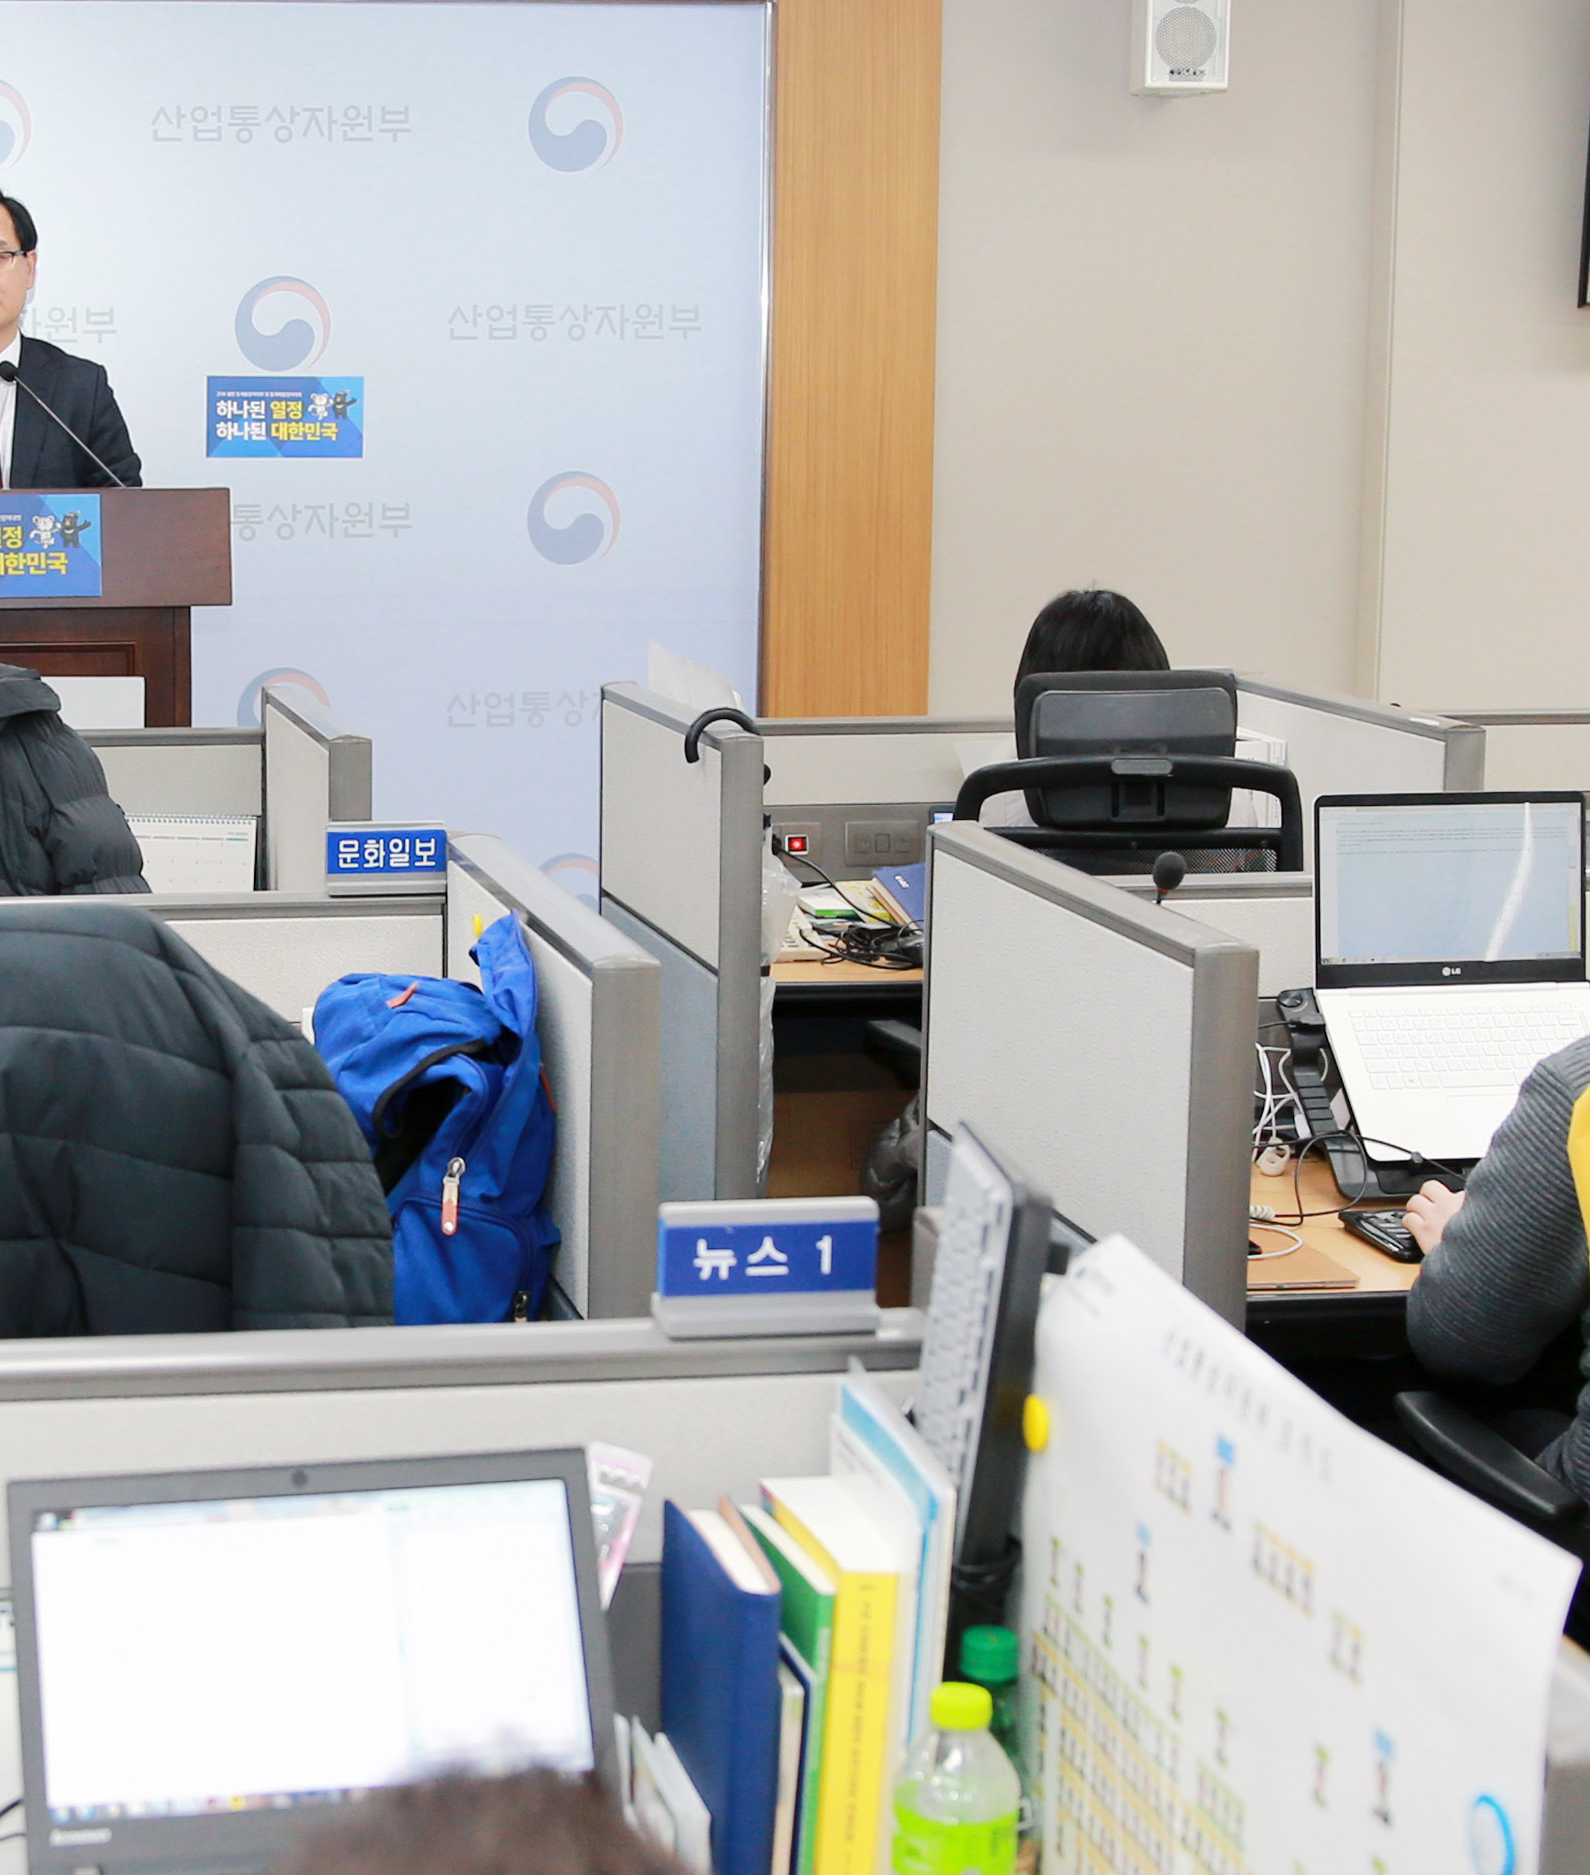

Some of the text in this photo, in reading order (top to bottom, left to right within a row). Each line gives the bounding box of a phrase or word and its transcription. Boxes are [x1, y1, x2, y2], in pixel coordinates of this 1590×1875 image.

[150, 104, 412, 144] 산업통상자원부
[447, 303, 702, 342] 산업통상자원부
[216, 400, 303, 419] 하나된 열정
[216, 421, 339, 441] 하나된 대한민국
[231, 502, 413, 542] 통상자원부
[446, 690, 600, 729] 산업통상
[338, 838, 437, 869] 문화일보
[692, 1234, 833, 1281] 뉴스 1
